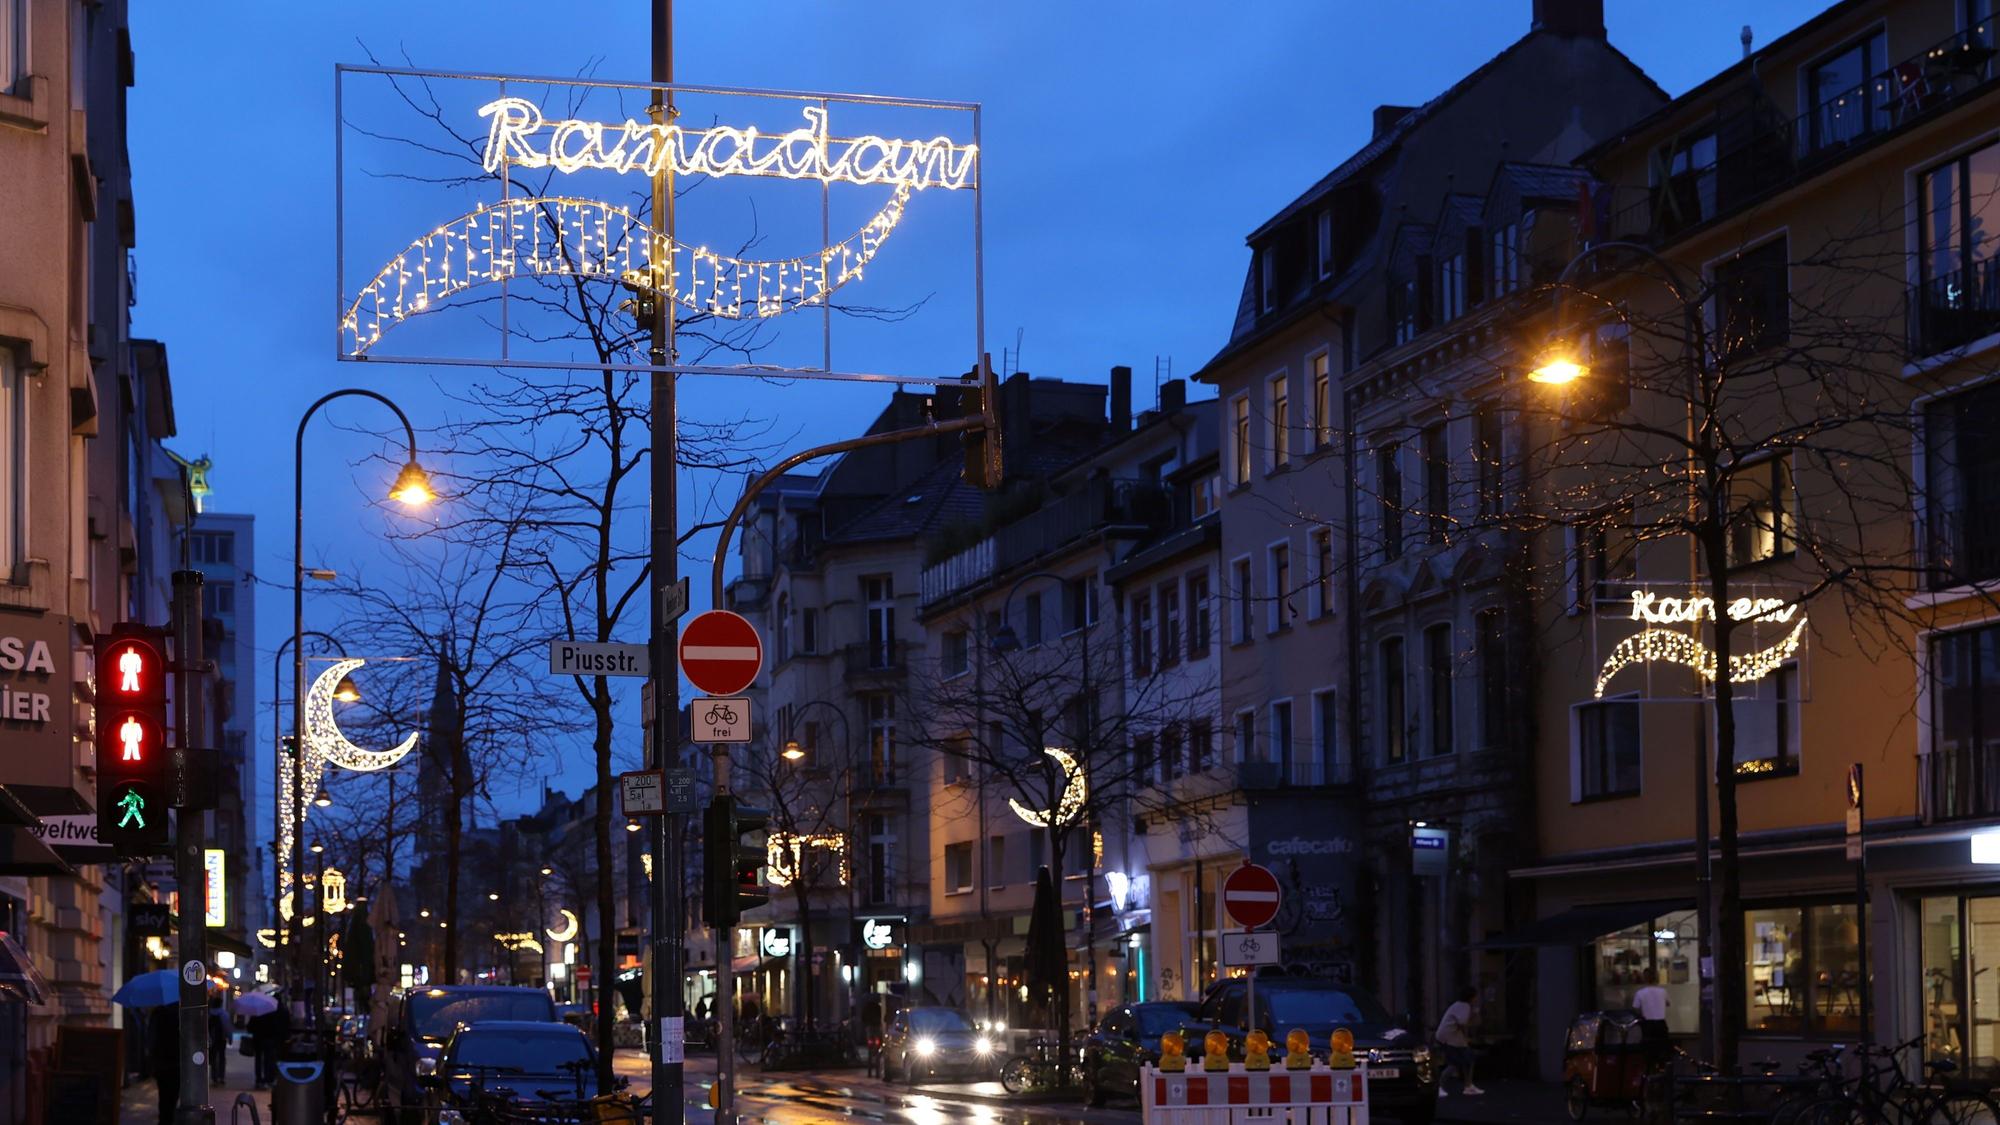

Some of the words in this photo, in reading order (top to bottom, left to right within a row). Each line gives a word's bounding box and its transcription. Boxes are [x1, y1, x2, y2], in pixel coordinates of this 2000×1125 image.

[478, 97, 979, 190] Ramadan
[1631, 590, 1797, 624] Karem
[0, 636, 56, 674] SA
[561, 646, 639, 673] Piusstr.
[712, 726, 732, 738] frei
[623, 777, 630, 787] H
[635, 775, 652, 787] 200
[135, 911, 166, 929] sky
